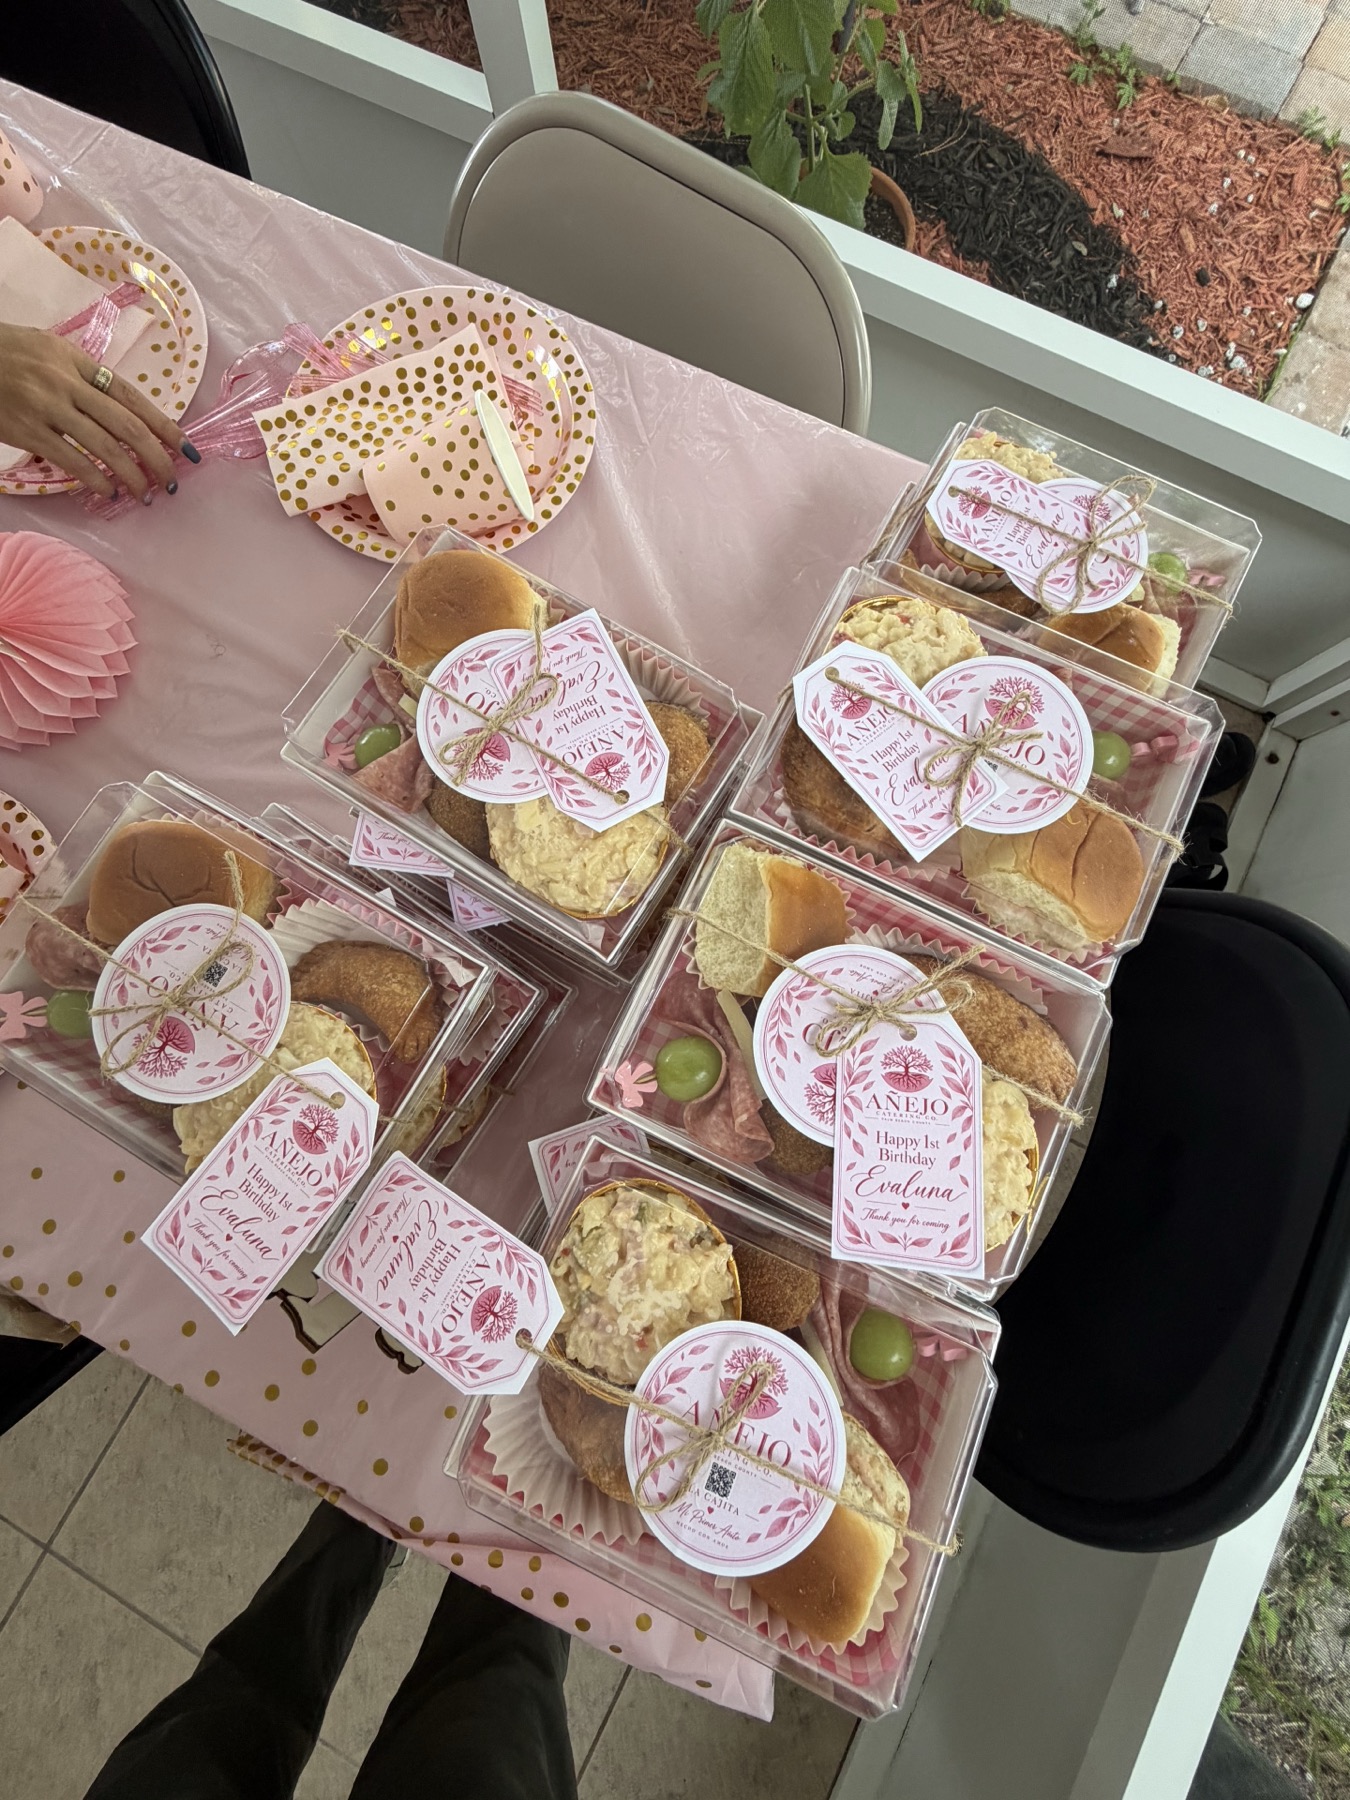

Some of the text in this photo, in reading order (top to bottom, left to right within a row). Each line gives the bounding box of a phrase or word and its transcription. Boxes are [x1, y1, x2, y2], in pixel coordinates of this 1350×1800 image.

[553, 695, 598, 721] Birthday
[555, 705, 607, 735] Happy 1st
[562, 725, 624, 765] AÑEJO
[871, 730, 913, 764] Happy 1st
[882, 742, 920, 772] Birthday
[865, 1090, 949, 1116] AÑEJO
[876, 1111, 921, 1119] CATERING
[261, 1131, 323, 1187] AÑEJO
[876, 1130, 940, 1151] Happy 1st
[879, 1147, 937, 1170] Birthday
[238, 1178, 280, 1223] Birthday
[247, 1163, 293, 1211] Happy 1st
[850, 1164, 967, 1202] Evaluna
[200, 1185, 280, 1261] Evaluna
[360, 1191, 412, 1269] Thank you for coming
[860, 1207, 950, 1234] Thank you for coming
[187, 1218, 247, 1280] Thank you for coming
[375, 1199, 440, 1302] Evaluna
[409, 1238, 447, 1291] Birthday
[419, 1244, 461, 1304] Happy 1st
[441, 1252, 491, 1333] AÑEJO
[669, 1501, 689, 1518] Mi
[704, 1492, 739, 1516] CAJITA
